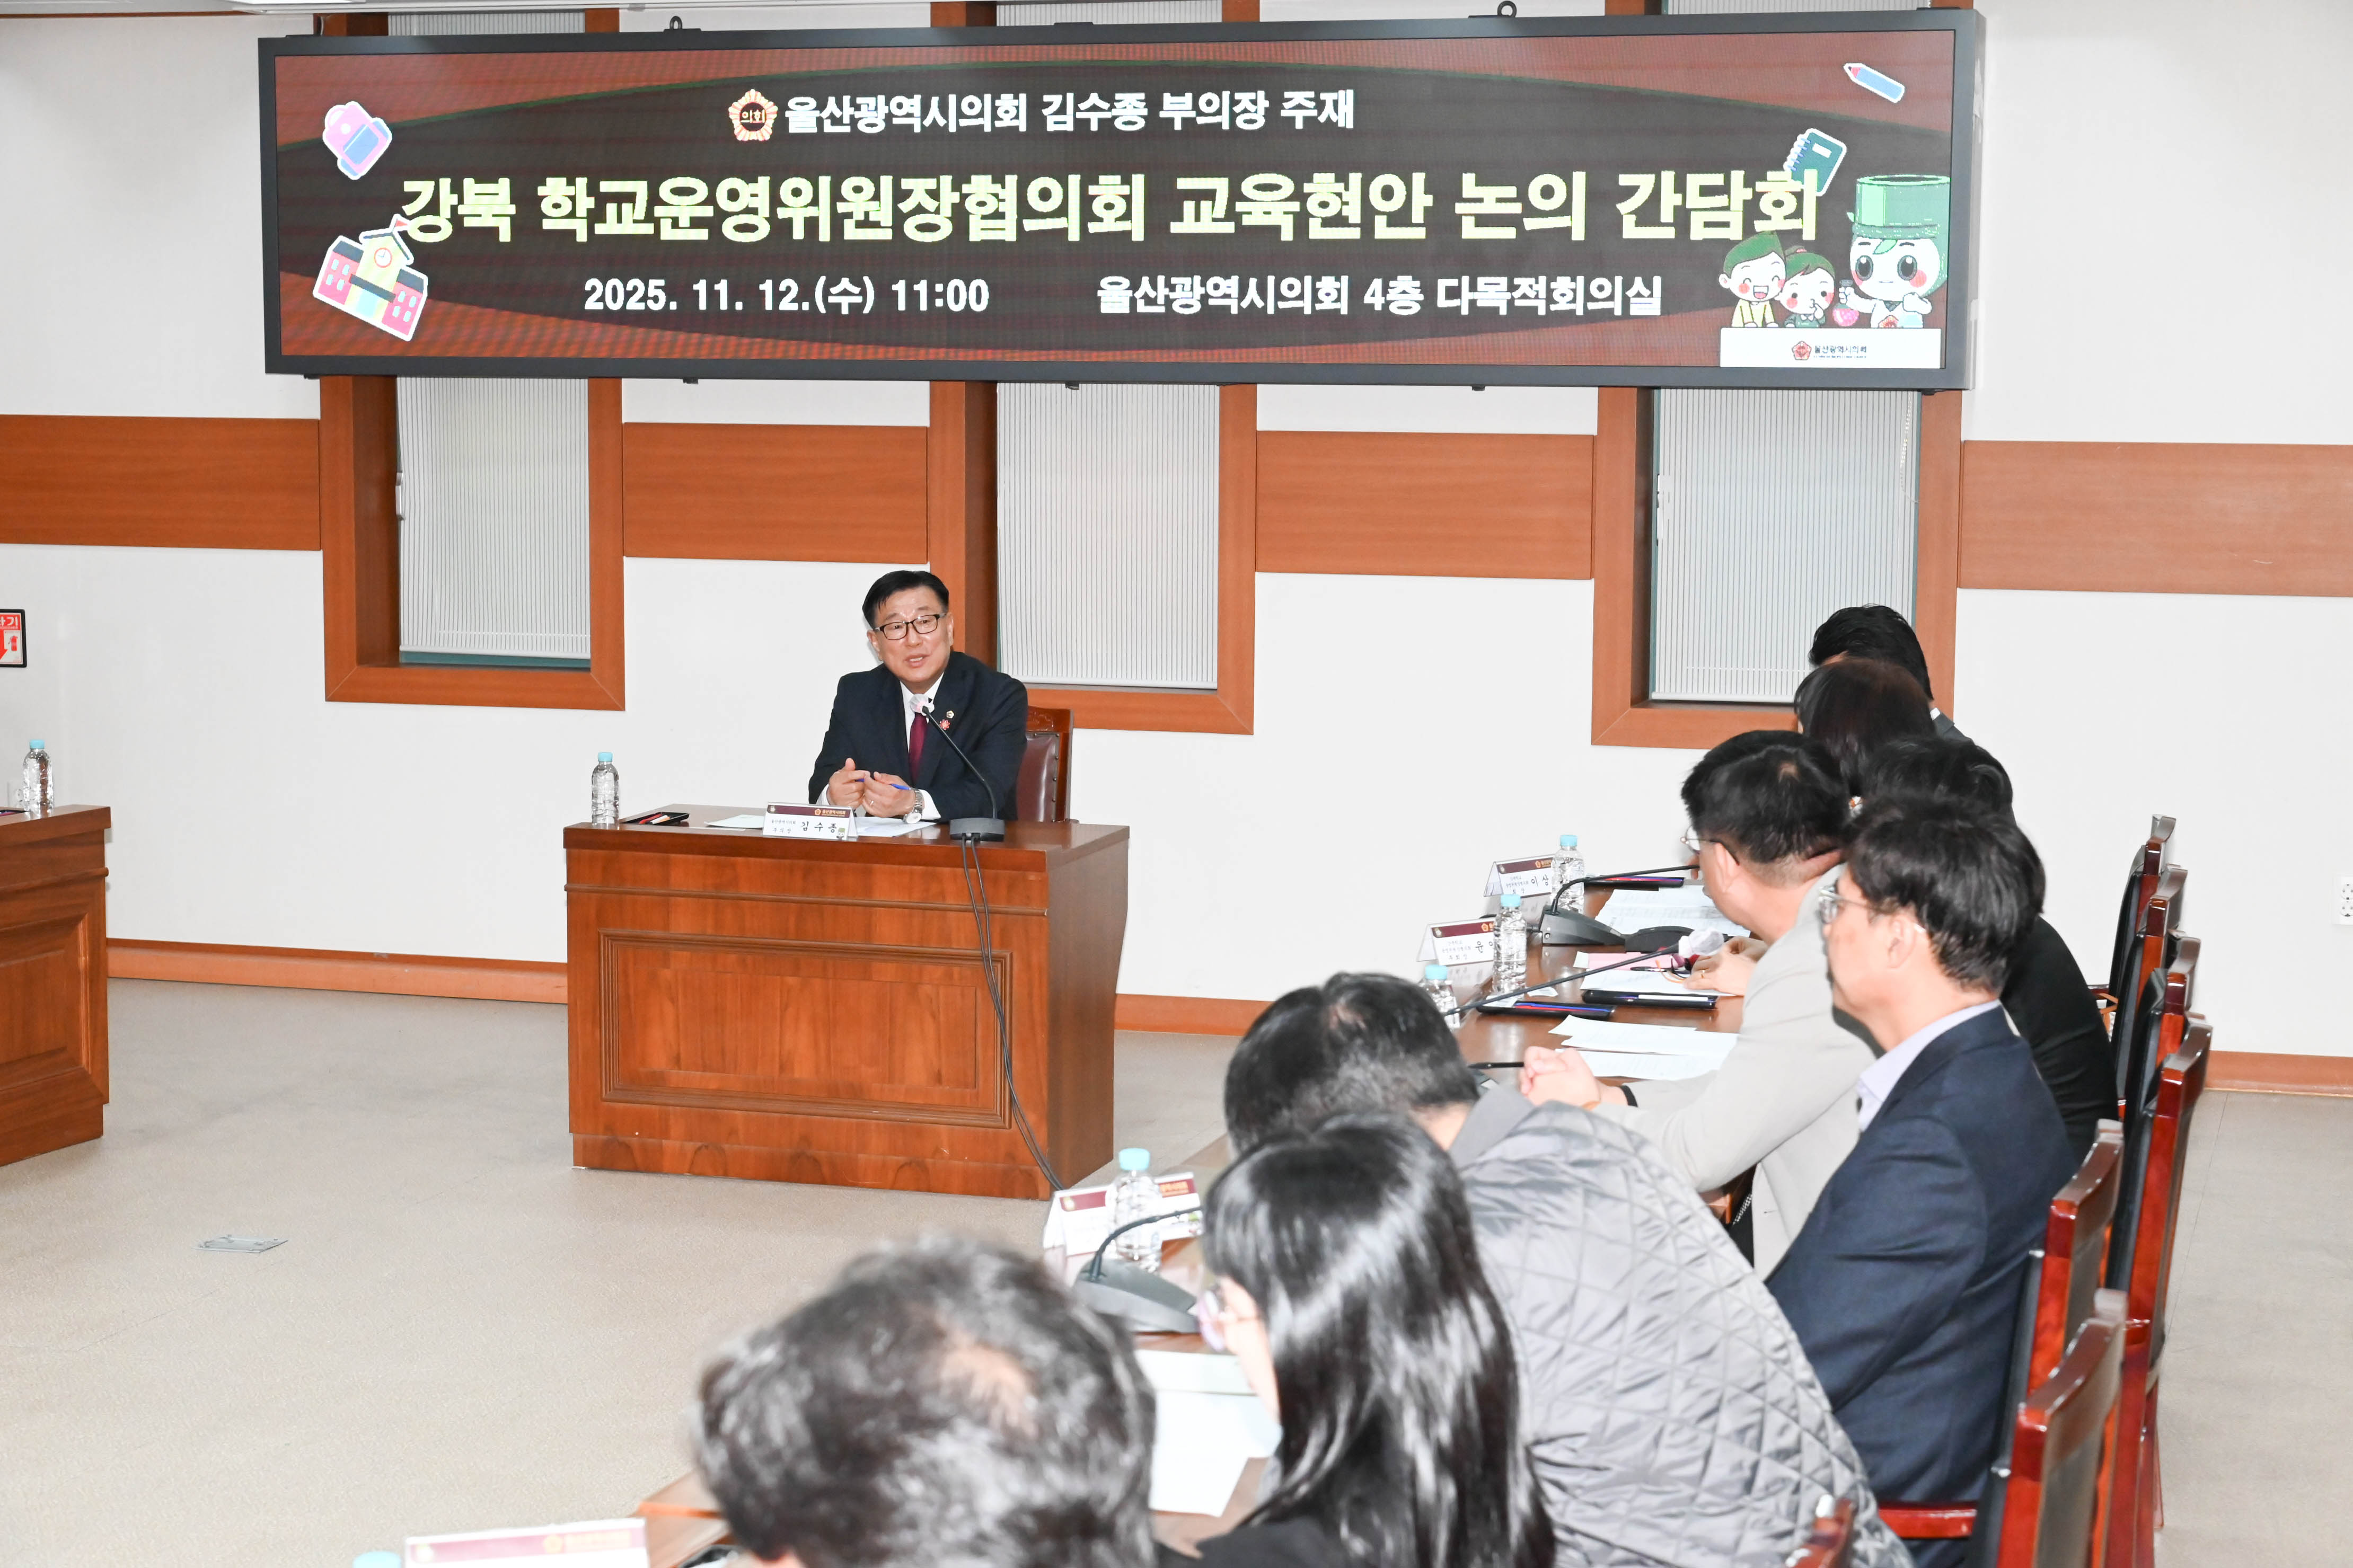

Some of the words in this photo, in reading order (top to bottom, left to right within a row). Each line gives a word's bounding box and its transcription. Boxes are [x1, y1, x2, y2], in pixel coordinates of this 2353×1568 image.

[785, 93, 1027, 133] 울산광역시의회
[1041, 92, 1148, 131] 김수종
[1159, 90, 1270, 130] 부의장
[1280, 89, 1354, 129] 주재
[401, 178, 516, 243] 강북
[537, 174, 1144, 243] 학교운영위원장협의회
[1170, 172, 1433, 241] 교육현안
[1455, 171, 1586, 241] 논의
[1616, 169, 1818, 241] 간담회
[584, 278, 677, 311] 2025.
[693, 279, 743, 311] 11.
[759, 276, 875, 315] 12.(수)
[892, 279, 989, 312] 11:00
[1097, 275, 1349, 315] 울산광역시의회
[1363, 275, 1424, 316] 4층
[1437, 275, 1662, 316] 다목적회의실
